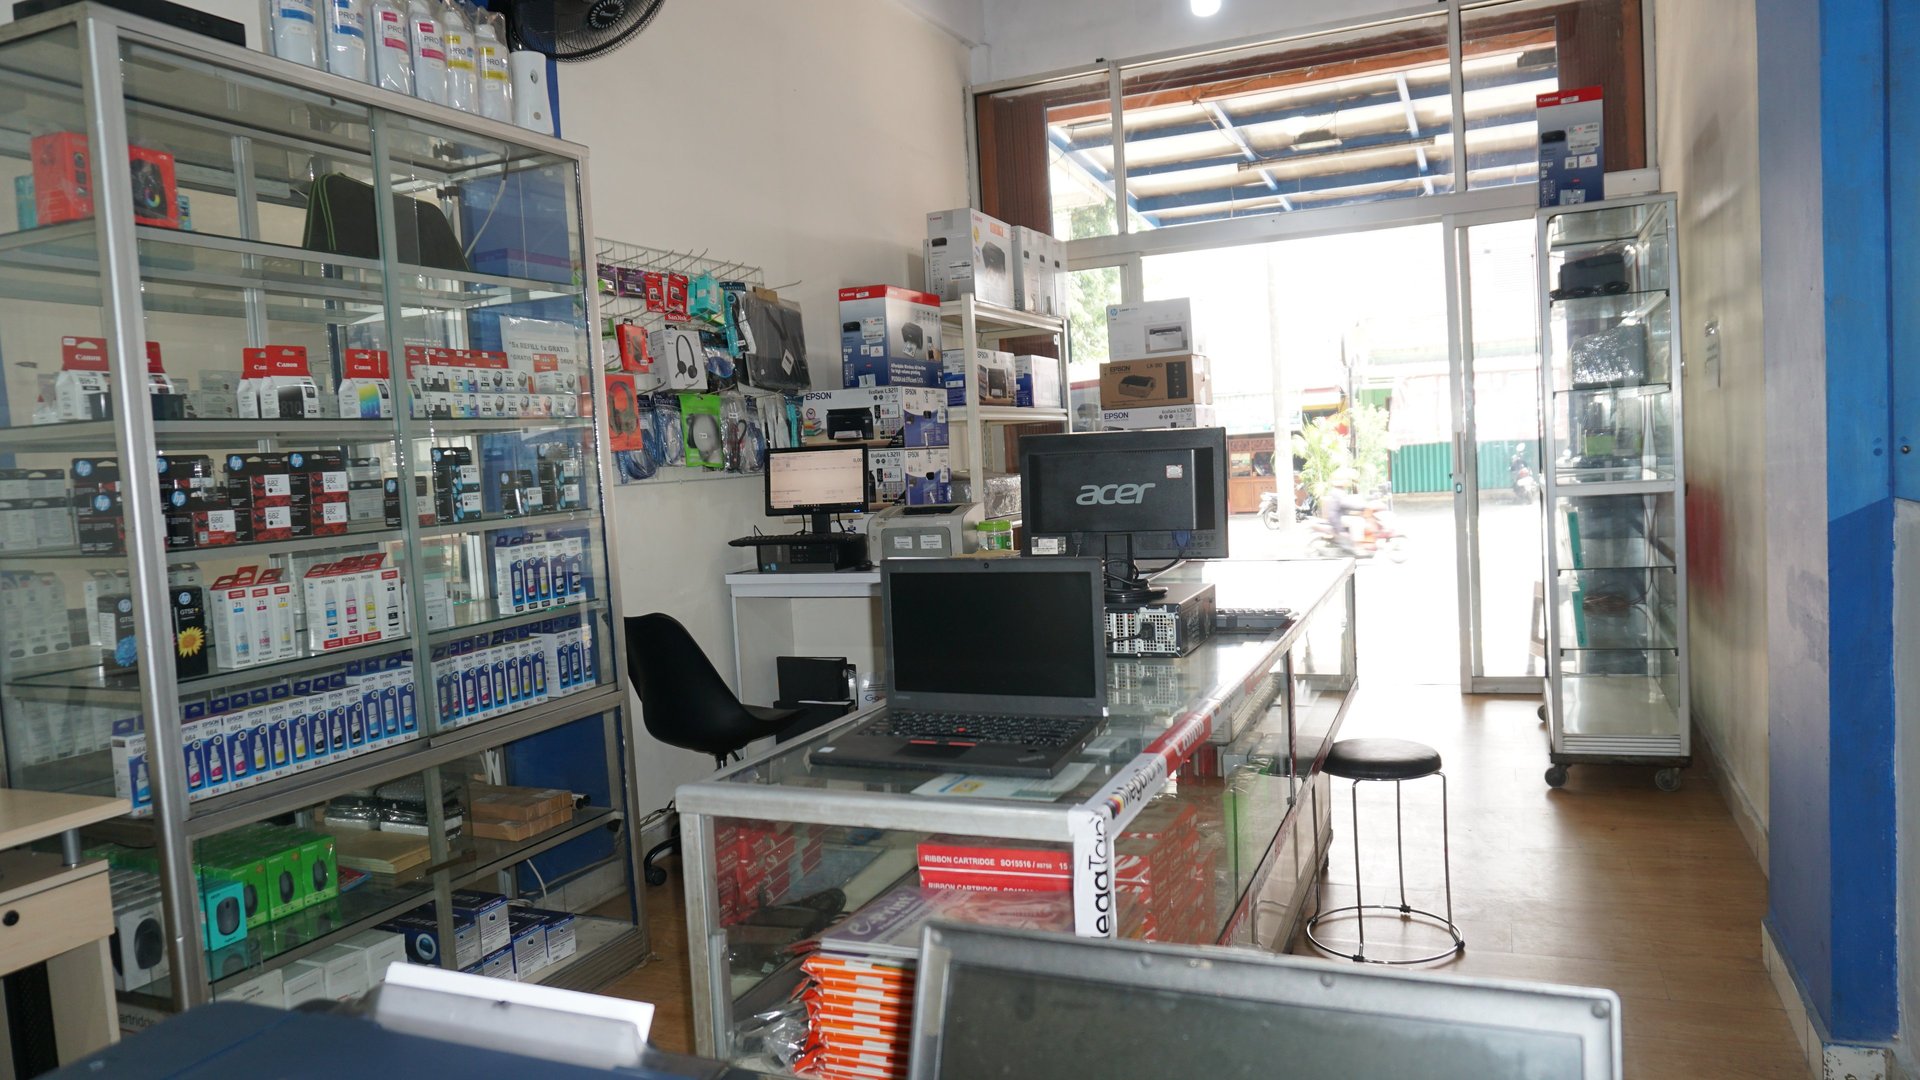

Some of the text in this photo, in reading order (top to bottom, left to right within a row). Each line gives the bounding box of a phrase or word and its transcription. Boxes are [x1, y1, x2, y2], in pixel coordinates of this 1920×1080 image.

[338, 11, 355, 21] PRO
[424, 35, 440, 45] PRO
[805, 392, 832, 401] EPSON
[1104, 412, 1129, 420] EPSON
[229, 456, 243, 470] hp
[290, 454, 303, 467] hp
[76, 461, 91, 476] hp
[267, 479, 279, 487] 682
[1076, 483, 1156, 506] acer
[95, 496, 110, 510] hp
[171, 492, 185, 506] hp
[398, 669, 412, 677] EPSON
[346, 688, 360, 696] EPSON
[289, 700, 304, 708] EPSON
[309, 696, 324, 704] EPSON
[269, 705, 284, 713] EPSON
[312, 704, 322, 712] 664
[248, 709, 265, 717] EPSON
[271, 712, 282, 721] 664
[226, 715, 243, 724] EPSON
[251, 718, 262, 726] 664
[202, 720, 220, 728] EPSON
[181, 725, 198, 733] EPSON
[924, 855, 952, 864] RIBBON
[954, 857, 995, 866] CARTRIDGE
